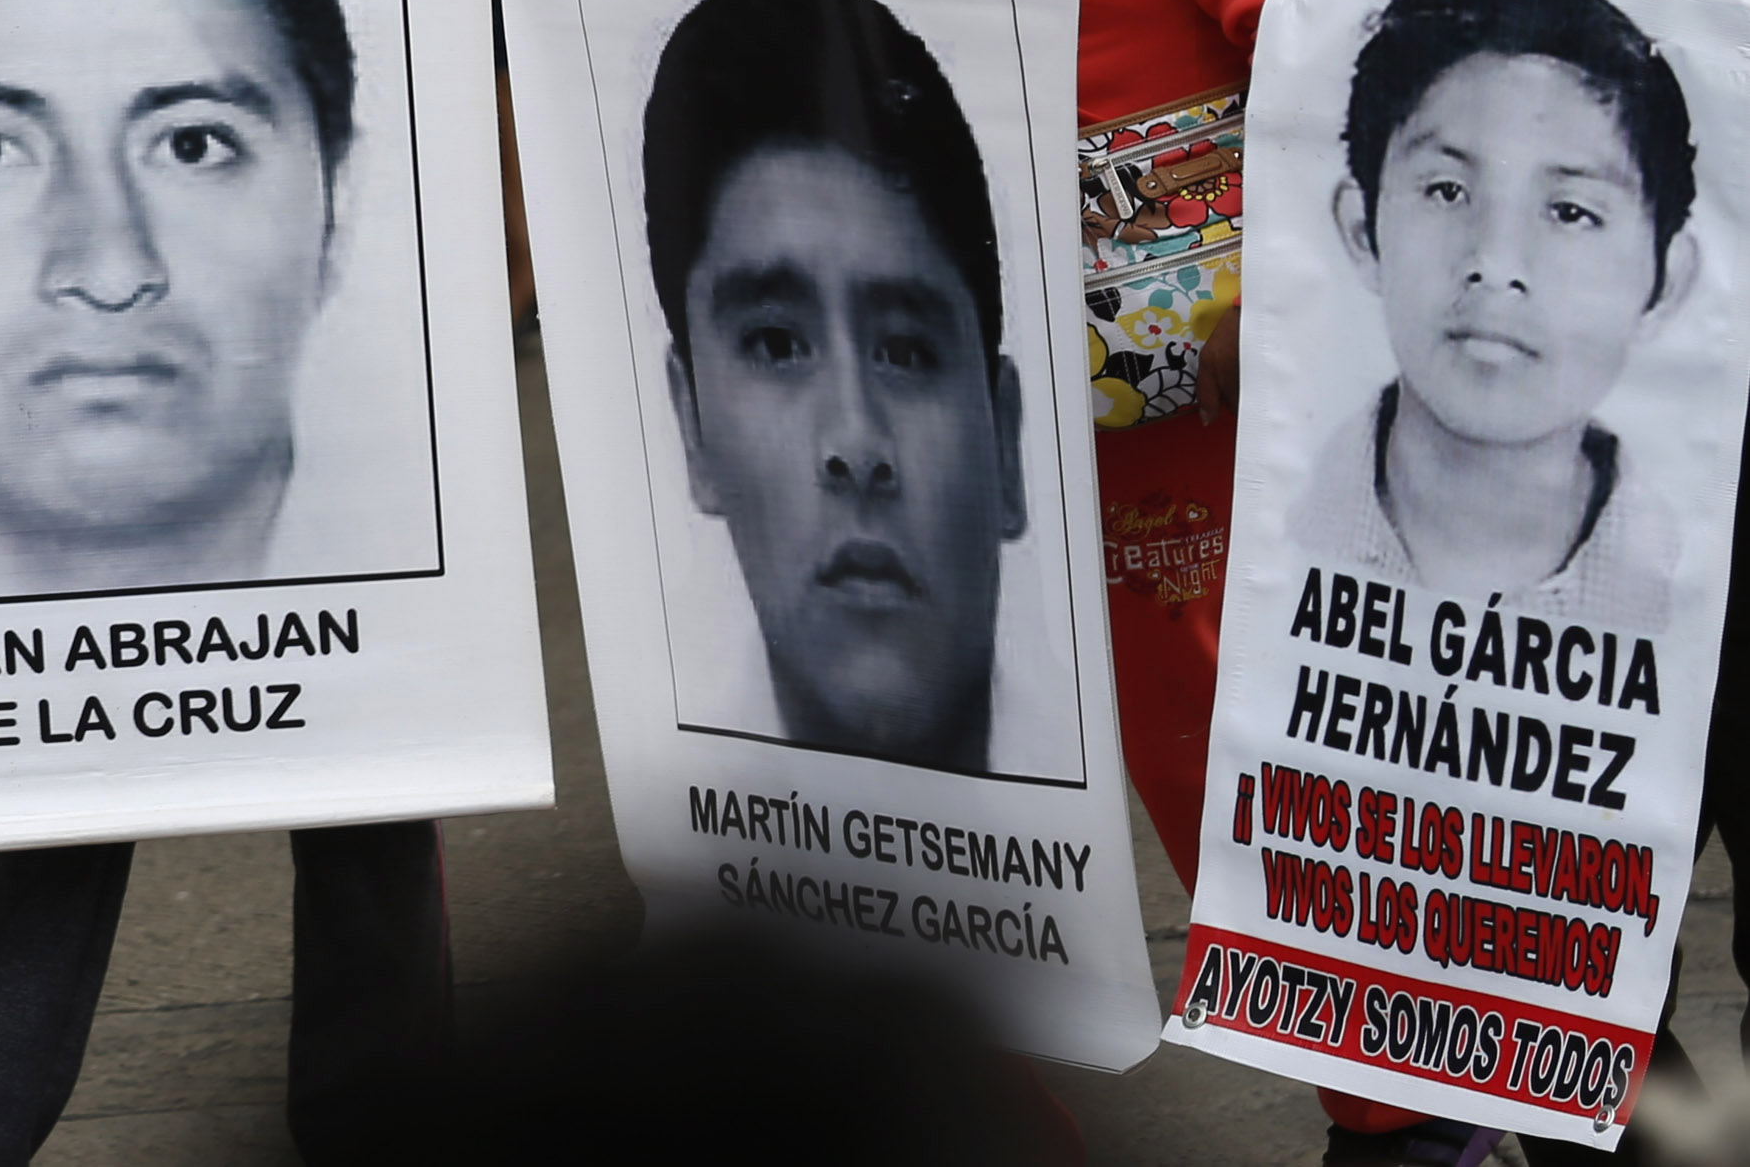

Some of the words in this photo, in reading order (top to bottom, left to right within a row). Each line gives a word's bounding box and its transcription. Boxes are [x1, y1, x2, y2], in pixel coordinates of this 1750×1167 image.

[65, 608, 360, 671] ABRAJAN
[1290, 567, 1413, 666] ABEL
[1429, 592, 1660, 715] GÁRCIA
[39, 696, 116, 743] LA
[133, 683, 306, 738] CRUZ
[1286, 665, 1636, 811] HERNÁNDEZ
[689, 786, 831, 854] MARTÍN
[843, 810, 1092, 892] GETSEMANY
[716, 857, 906, 937] SÁNCHEZ
[911, 902, 1070, 965] GARCÍA
[1261, 762, 1353, 852] VIVOS
[1355, 786, 1397, 864] SE
[1400, 798, 1464, 880] LOS
[1469, 811, 1660, 938] LLEVARON,
[1261, 847, 1355, 938] VIVOS
[1356, 872, 1420, 954] LOS
[1422, 889, 1622, 998] QUEREMOS!
[1190, 943, 1357, 1045] AYOTZY
[1362, 984, 1506, 1082] SOMOS
[1507, 1021, 1636, 1111] TODOS
